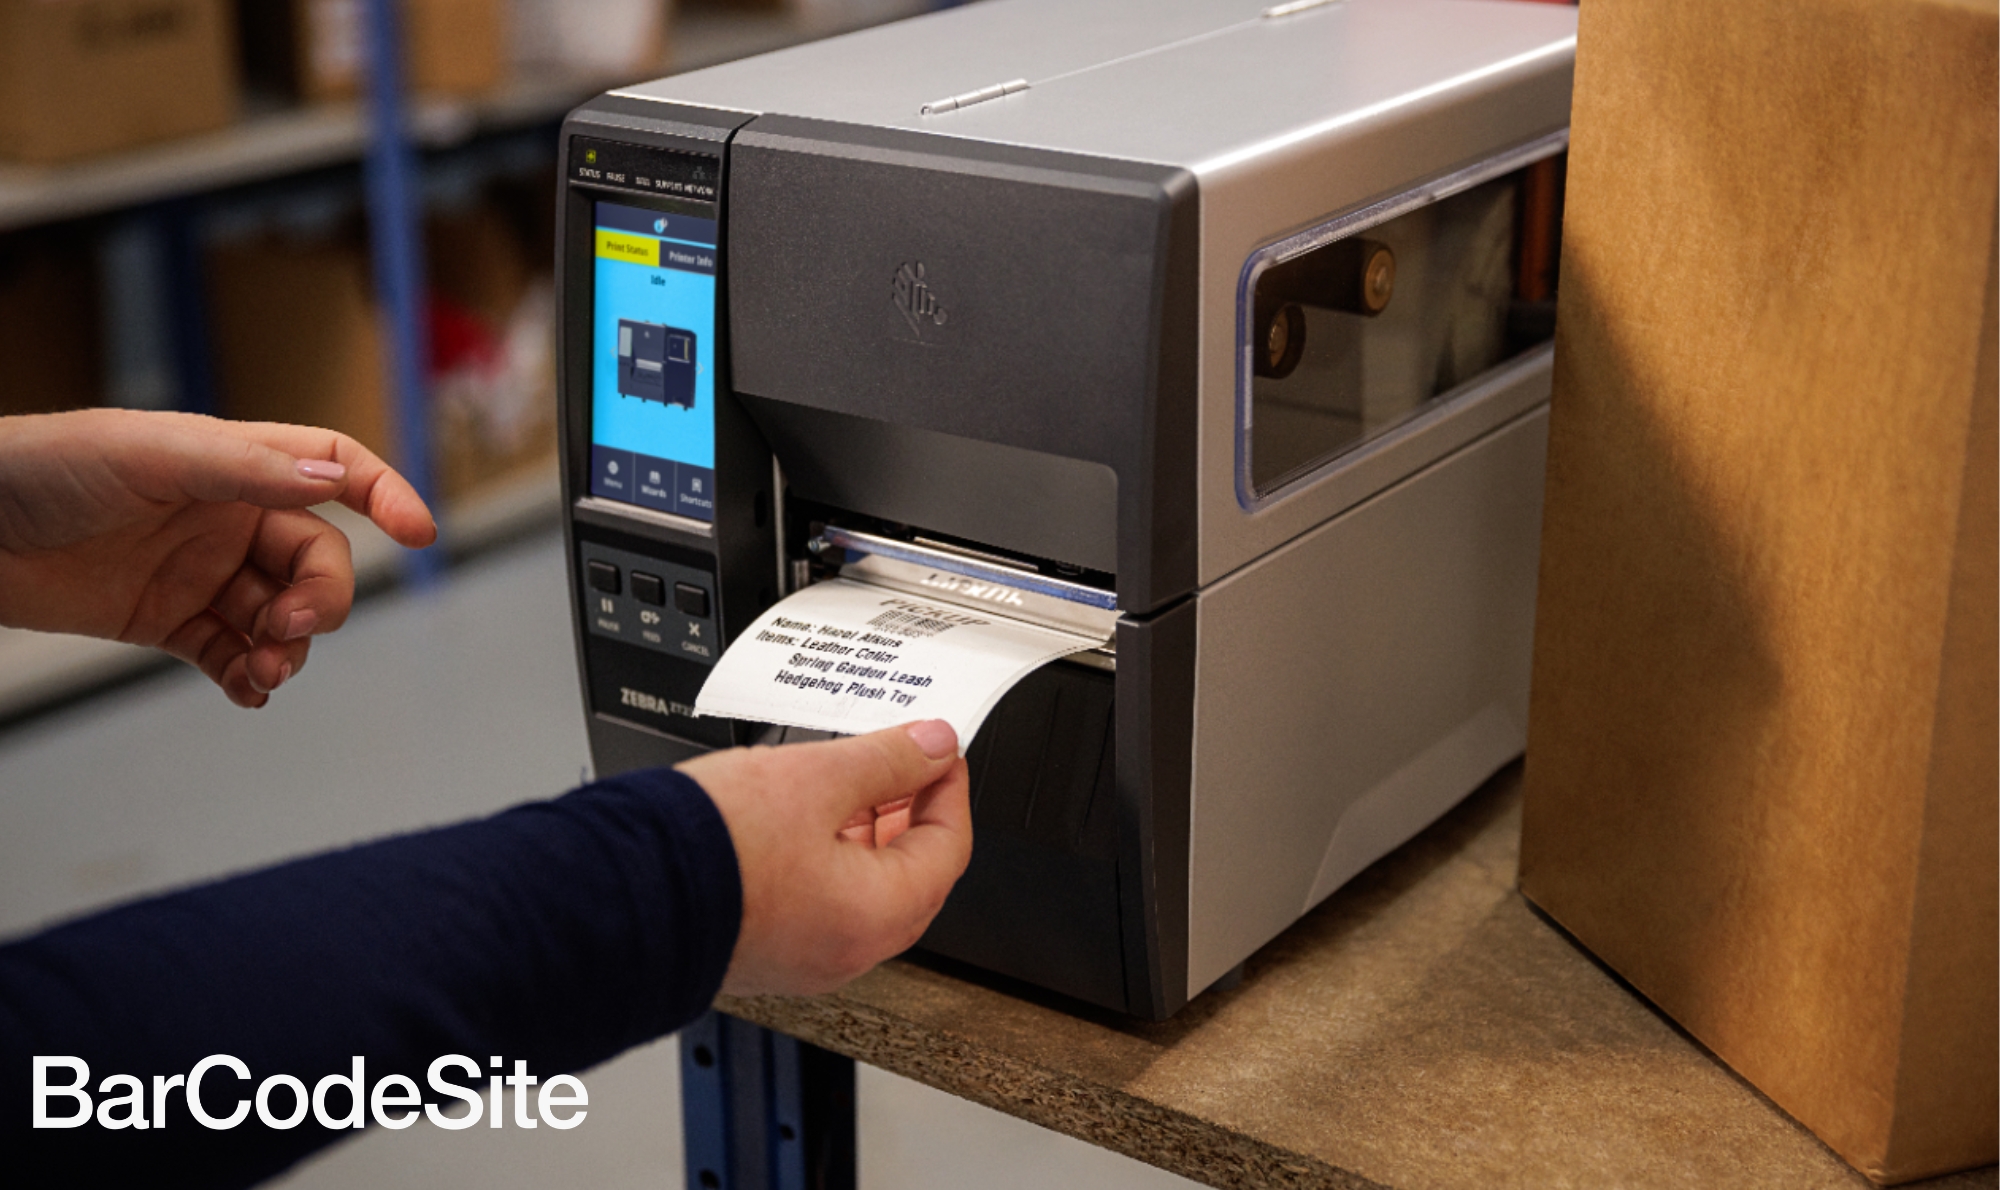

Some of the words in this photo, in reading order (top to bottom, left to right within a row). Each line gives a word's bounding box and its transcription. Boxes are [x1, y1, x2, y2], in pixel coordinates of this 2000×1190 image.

[579, 167, 601, 178] STATUS
[606, 171, 626, 183] PAUSE
[606, 240, 625, 253] Print
[626, 244, 649, 257] Status
[669, 251, 695, 265] Printer
[697, 255, 714, 268] Info
[650, 274, 666, 287] Idle
[603, 477, 623, 490] Menu
[680, 493, 713, 509] Shortcuts
[879, 599, 992, 626] PICKUP
[771, 616, 817, 633] Name:
[857, 633, 904, 648] Atkins
[681, 641, 711, 657] CANCEL
[755, 629, 800, 647] Items:
[800, 636, 856, 656] Leather
[855, 647, 900, 664] Collar
[788, 652, 835, 673] Spring
[888, 670, 934, 688] Leash
[774, 669, 844, 695] Hedgehog
[845, 681, 887, 700] Plush
[889, 689, 918, 708] Toy
[620, 687, 670, 716] ZEBRA
